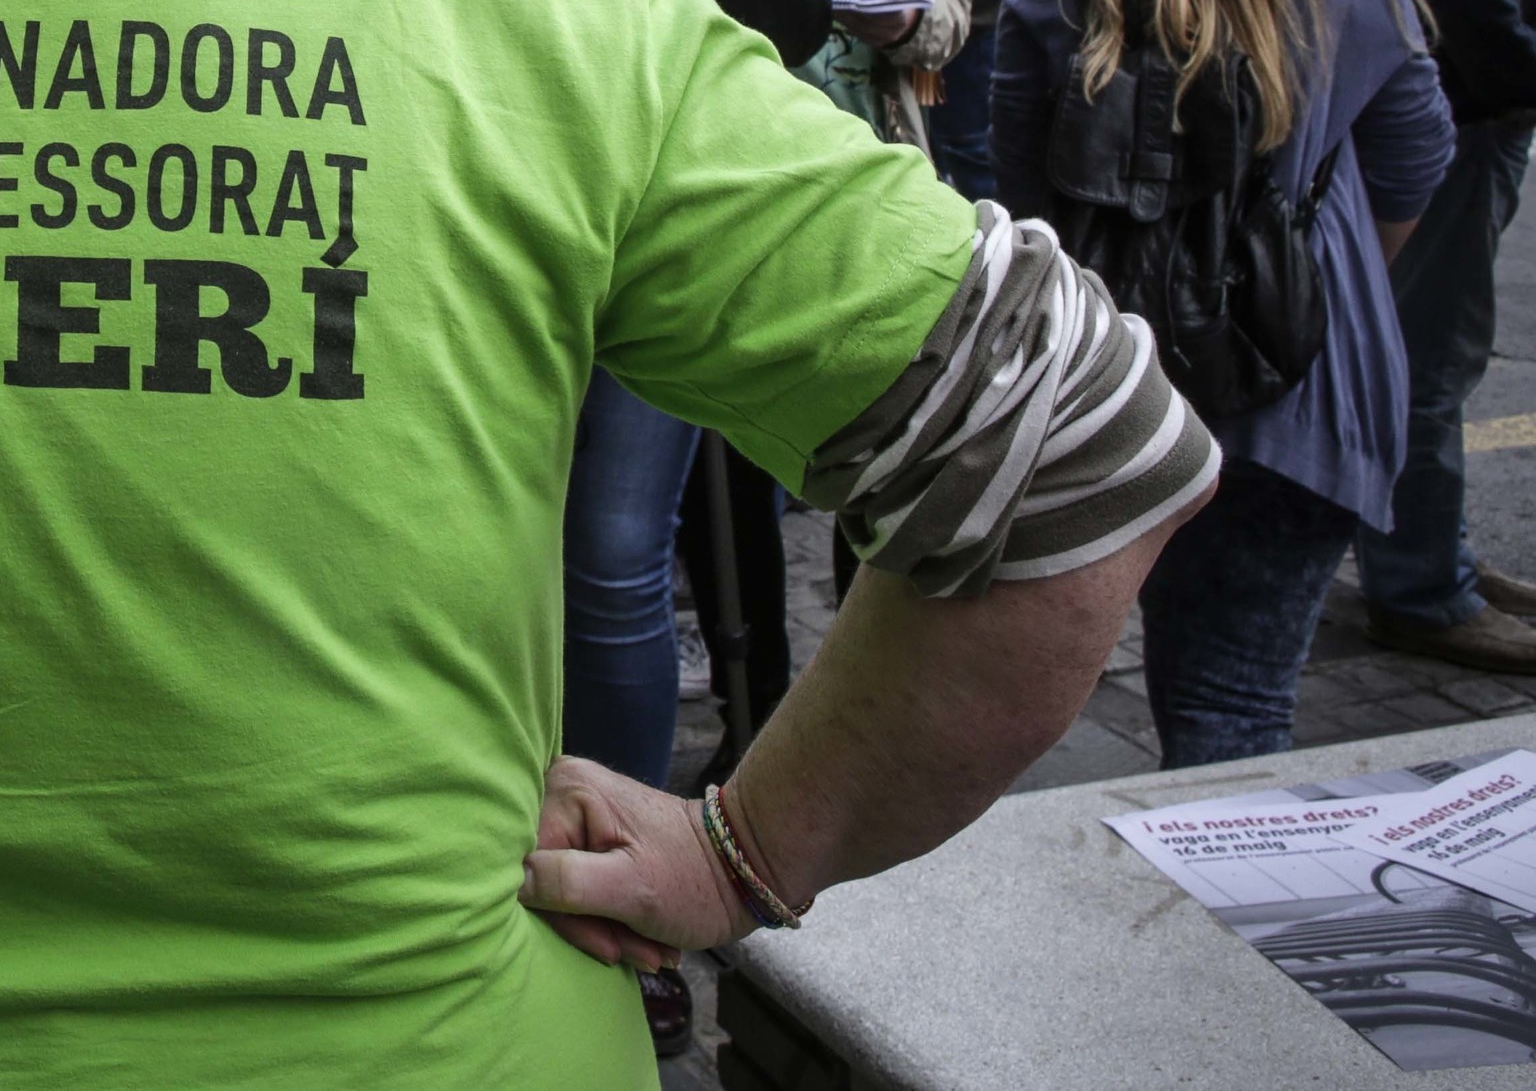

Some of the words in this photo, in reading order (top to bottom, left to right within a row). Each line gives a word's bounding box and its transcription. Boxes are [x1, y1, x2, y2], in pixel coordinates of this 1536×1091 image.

[1159, 818, 1198, 833] els
[1203, 813, 1298, 831] nostres
[1303, 805, 1379, 823] drets?
[1384, 824, 1416, 842] els
[1409, 798, 1475, 830] nostres
[1467, 773, 1523, 802] drets?
[1159, 833, 1209, 846] vaga
[1215, 830, 1242, 842] en
[1173, 845, 1197, 857] 16
[1201, 843, 1227, 854] de
[1233, 839, 1287, 852] maig
[1401, 836, 1441, 854] vaga
[1436, 827, 1461, 840] en
[1427, 849, 1451, 861] 16
[1444, 843, 1469, 855] de
[1464, 827, 1507, 848] maig
